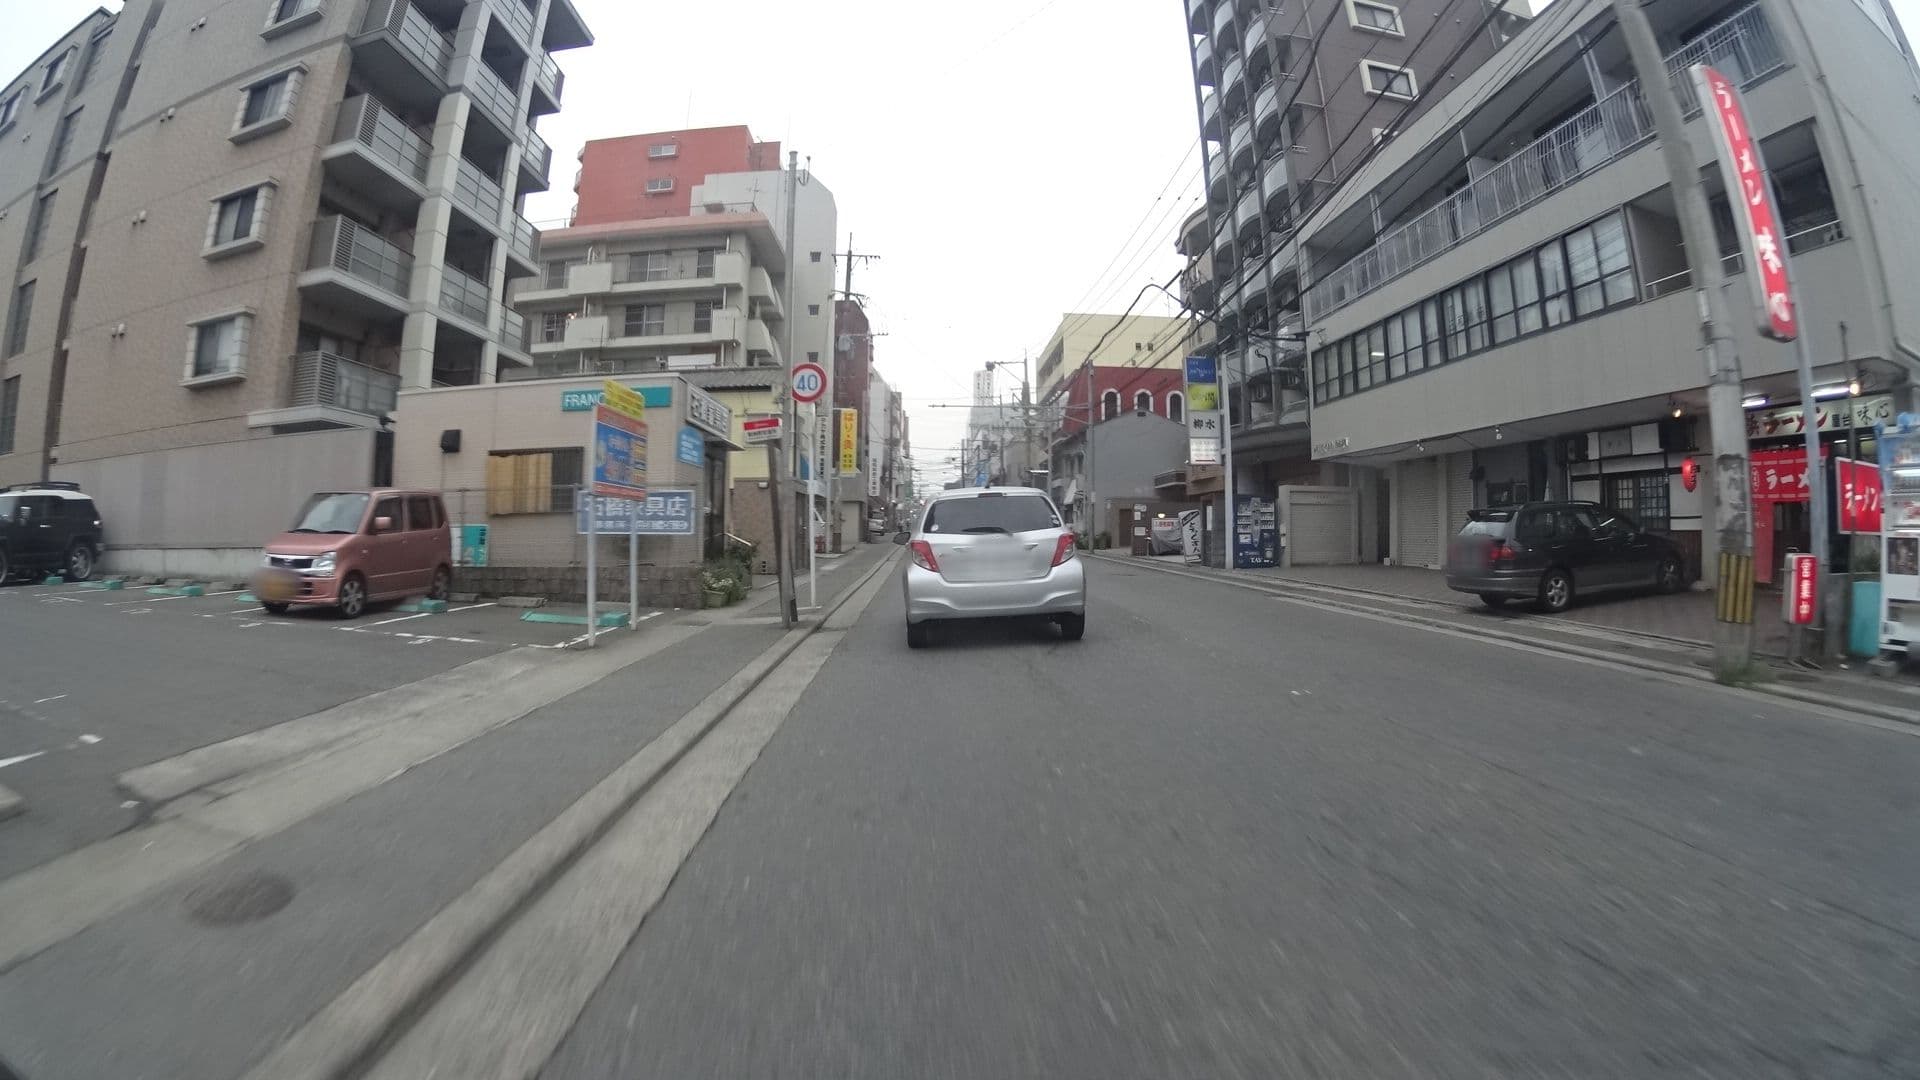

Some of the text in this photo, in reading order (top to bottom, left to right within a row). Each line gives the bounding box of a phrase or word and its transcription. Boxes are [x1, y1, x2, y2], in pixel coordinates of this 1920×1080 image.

[796, 374, 818, 391] 40
[564, 391, 606, 408] FRANC
[1765, 467, 1810, 490] ラーメ
[1844, 483, 1878, 511] ラーメン
